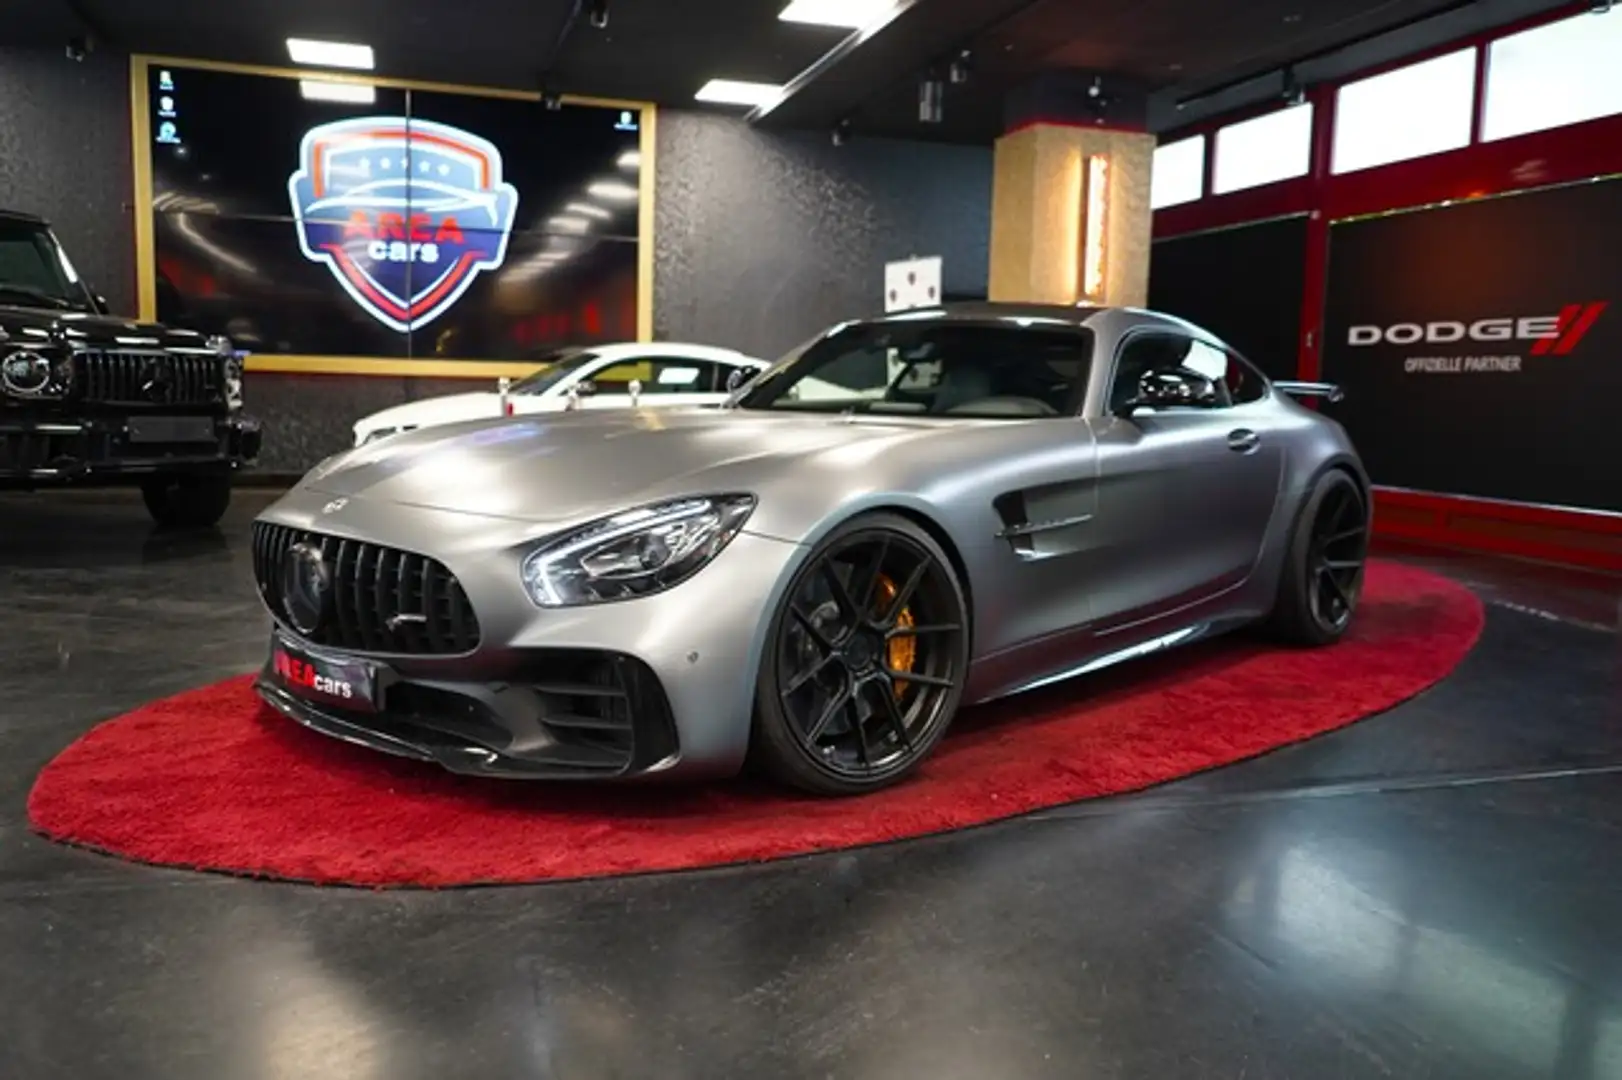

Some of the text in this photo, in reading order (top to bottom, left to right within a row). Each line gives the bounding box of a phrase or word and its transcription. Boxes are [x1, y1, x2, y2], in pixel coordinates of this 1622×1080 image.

[344, 210, 464, 244] AREA
[367, 240, 439, 262] cars
[1348, 316, 1560, 345] DODGE
[1404, 355, 1521, 373] OFFIZIELLE PARTNER
